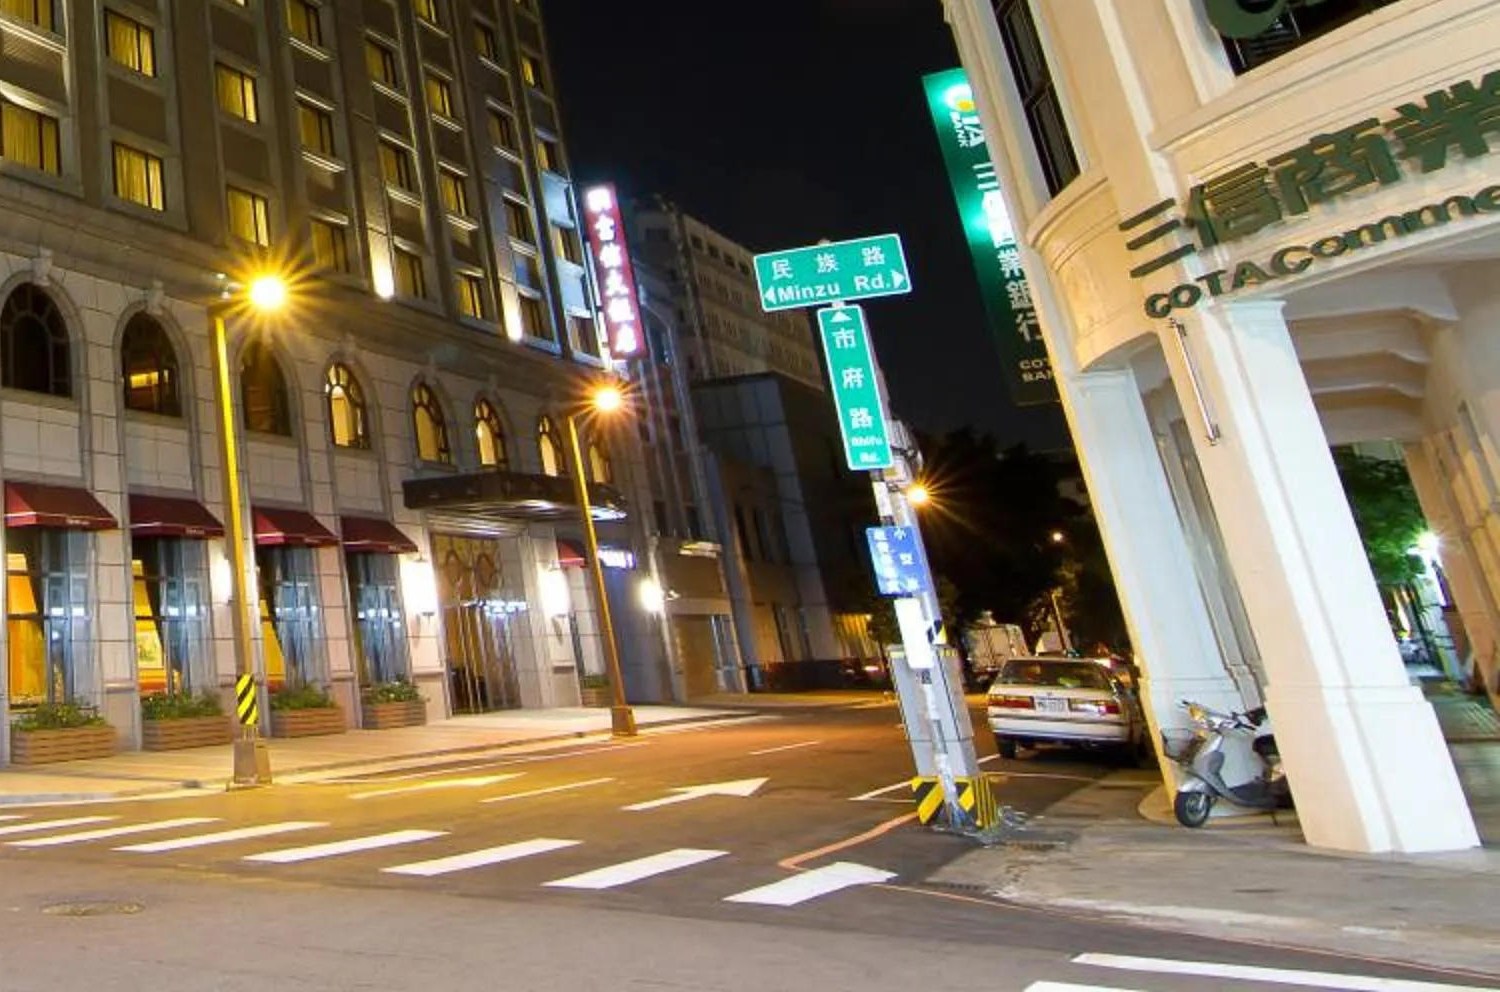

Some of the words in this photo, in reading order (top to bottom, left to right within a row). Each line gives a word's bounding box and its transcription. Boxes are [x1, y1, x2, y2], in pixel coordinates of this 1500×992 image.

[771, 246, 886, 281] 民族路
[777, 281, 842, 303] Minzu
[853, 273, 892, 293] Rd.
[831, 327, 874, 429] 市府路
